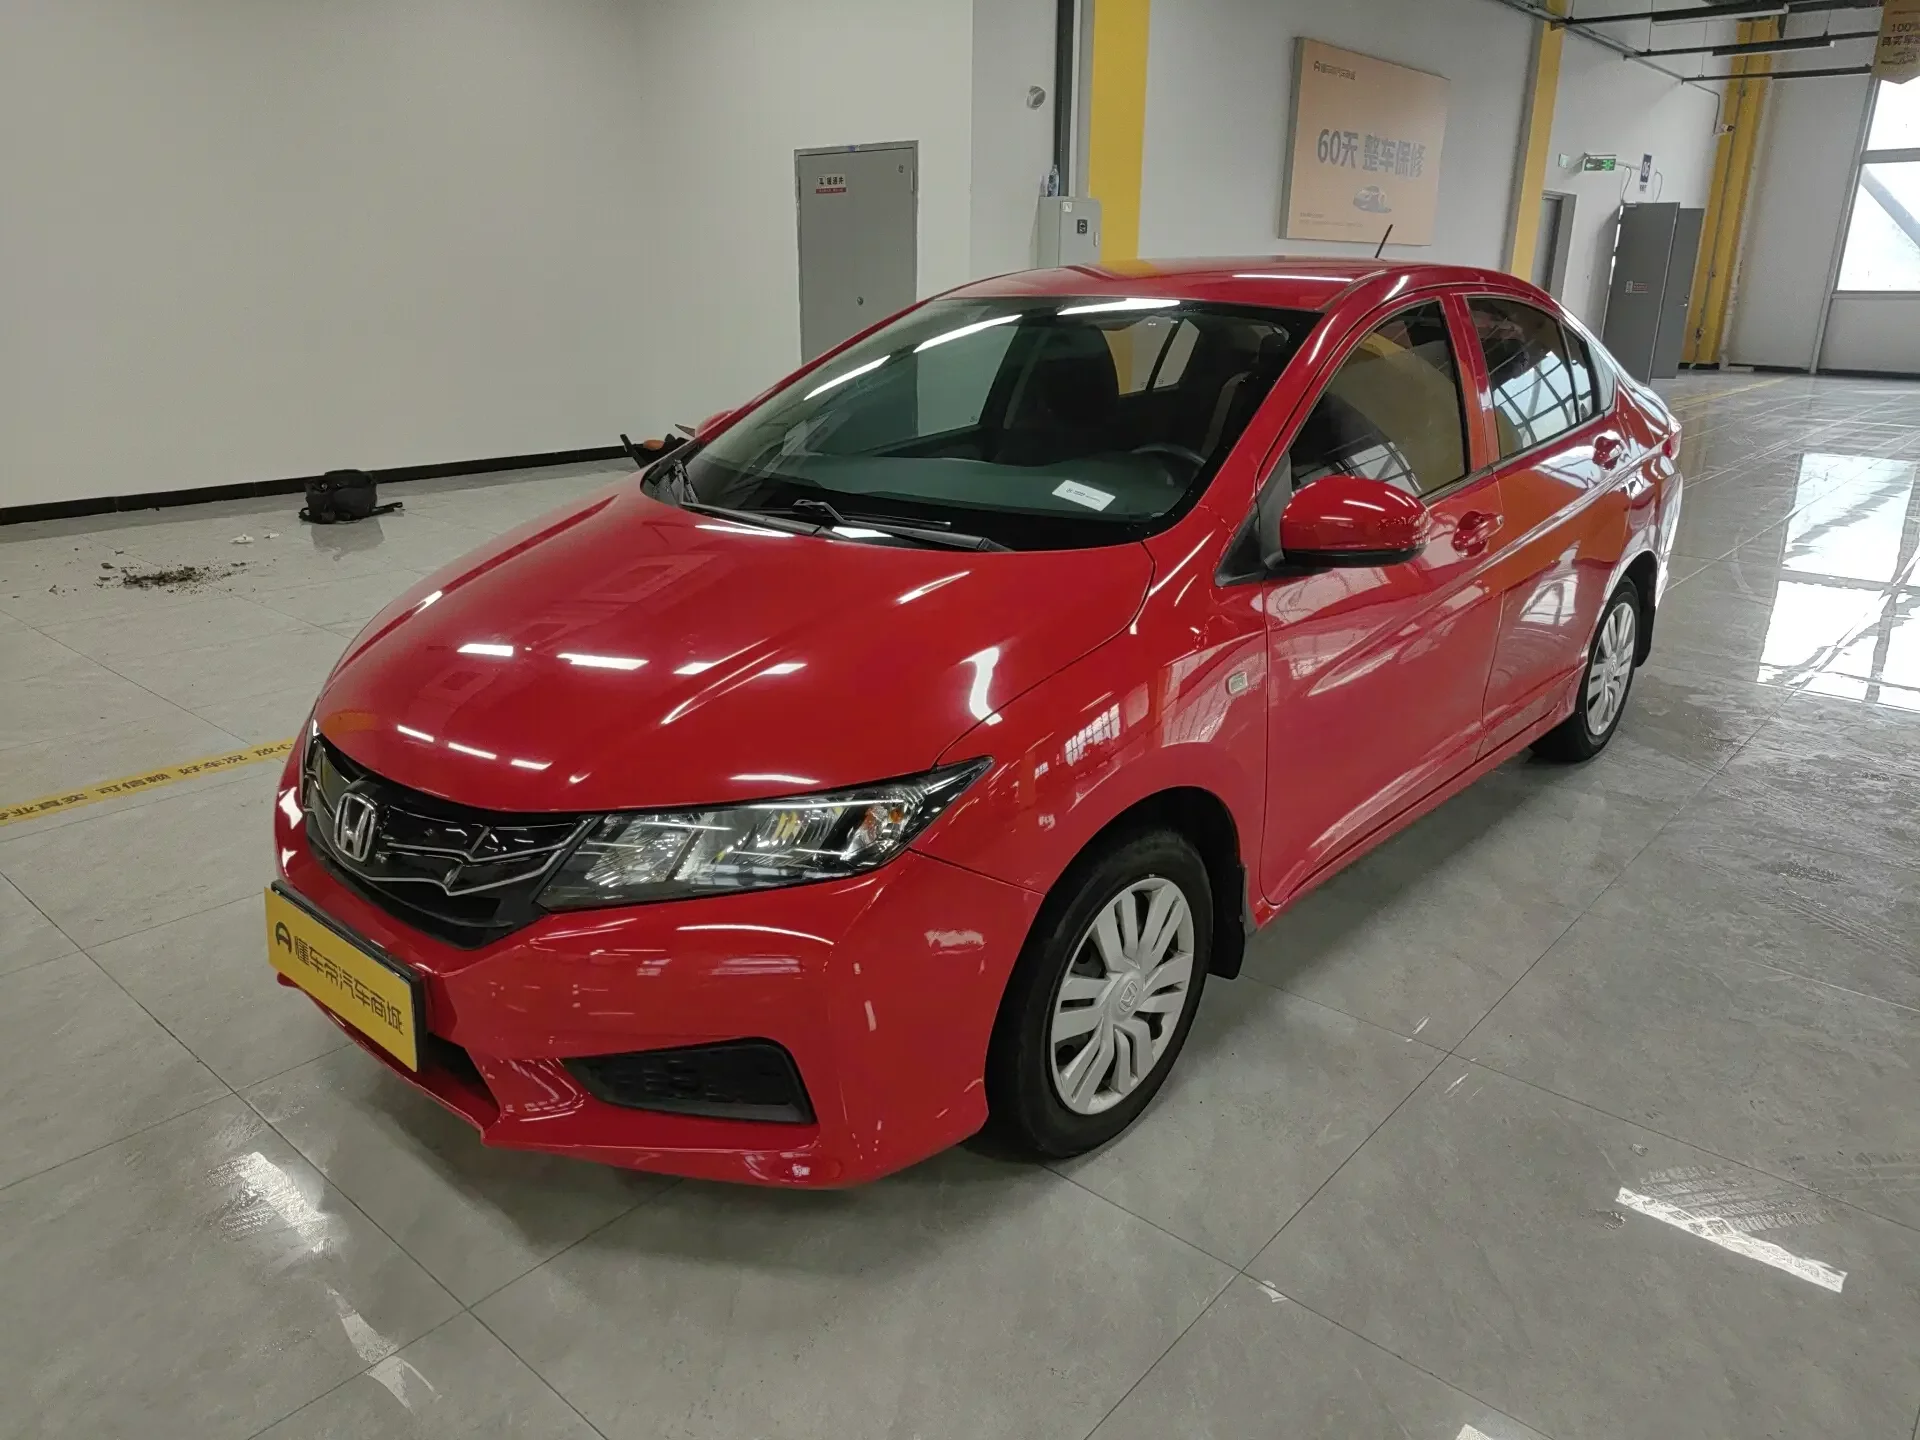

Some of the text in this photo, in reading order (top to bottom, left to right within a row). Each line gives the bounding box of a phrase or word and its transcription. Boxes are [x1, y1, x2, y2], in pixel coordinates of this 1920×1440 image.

[1317, 128, 1426, 178] 60天 整车保修
[294, 935, 404, 1036] 懂车帝汽车商城
